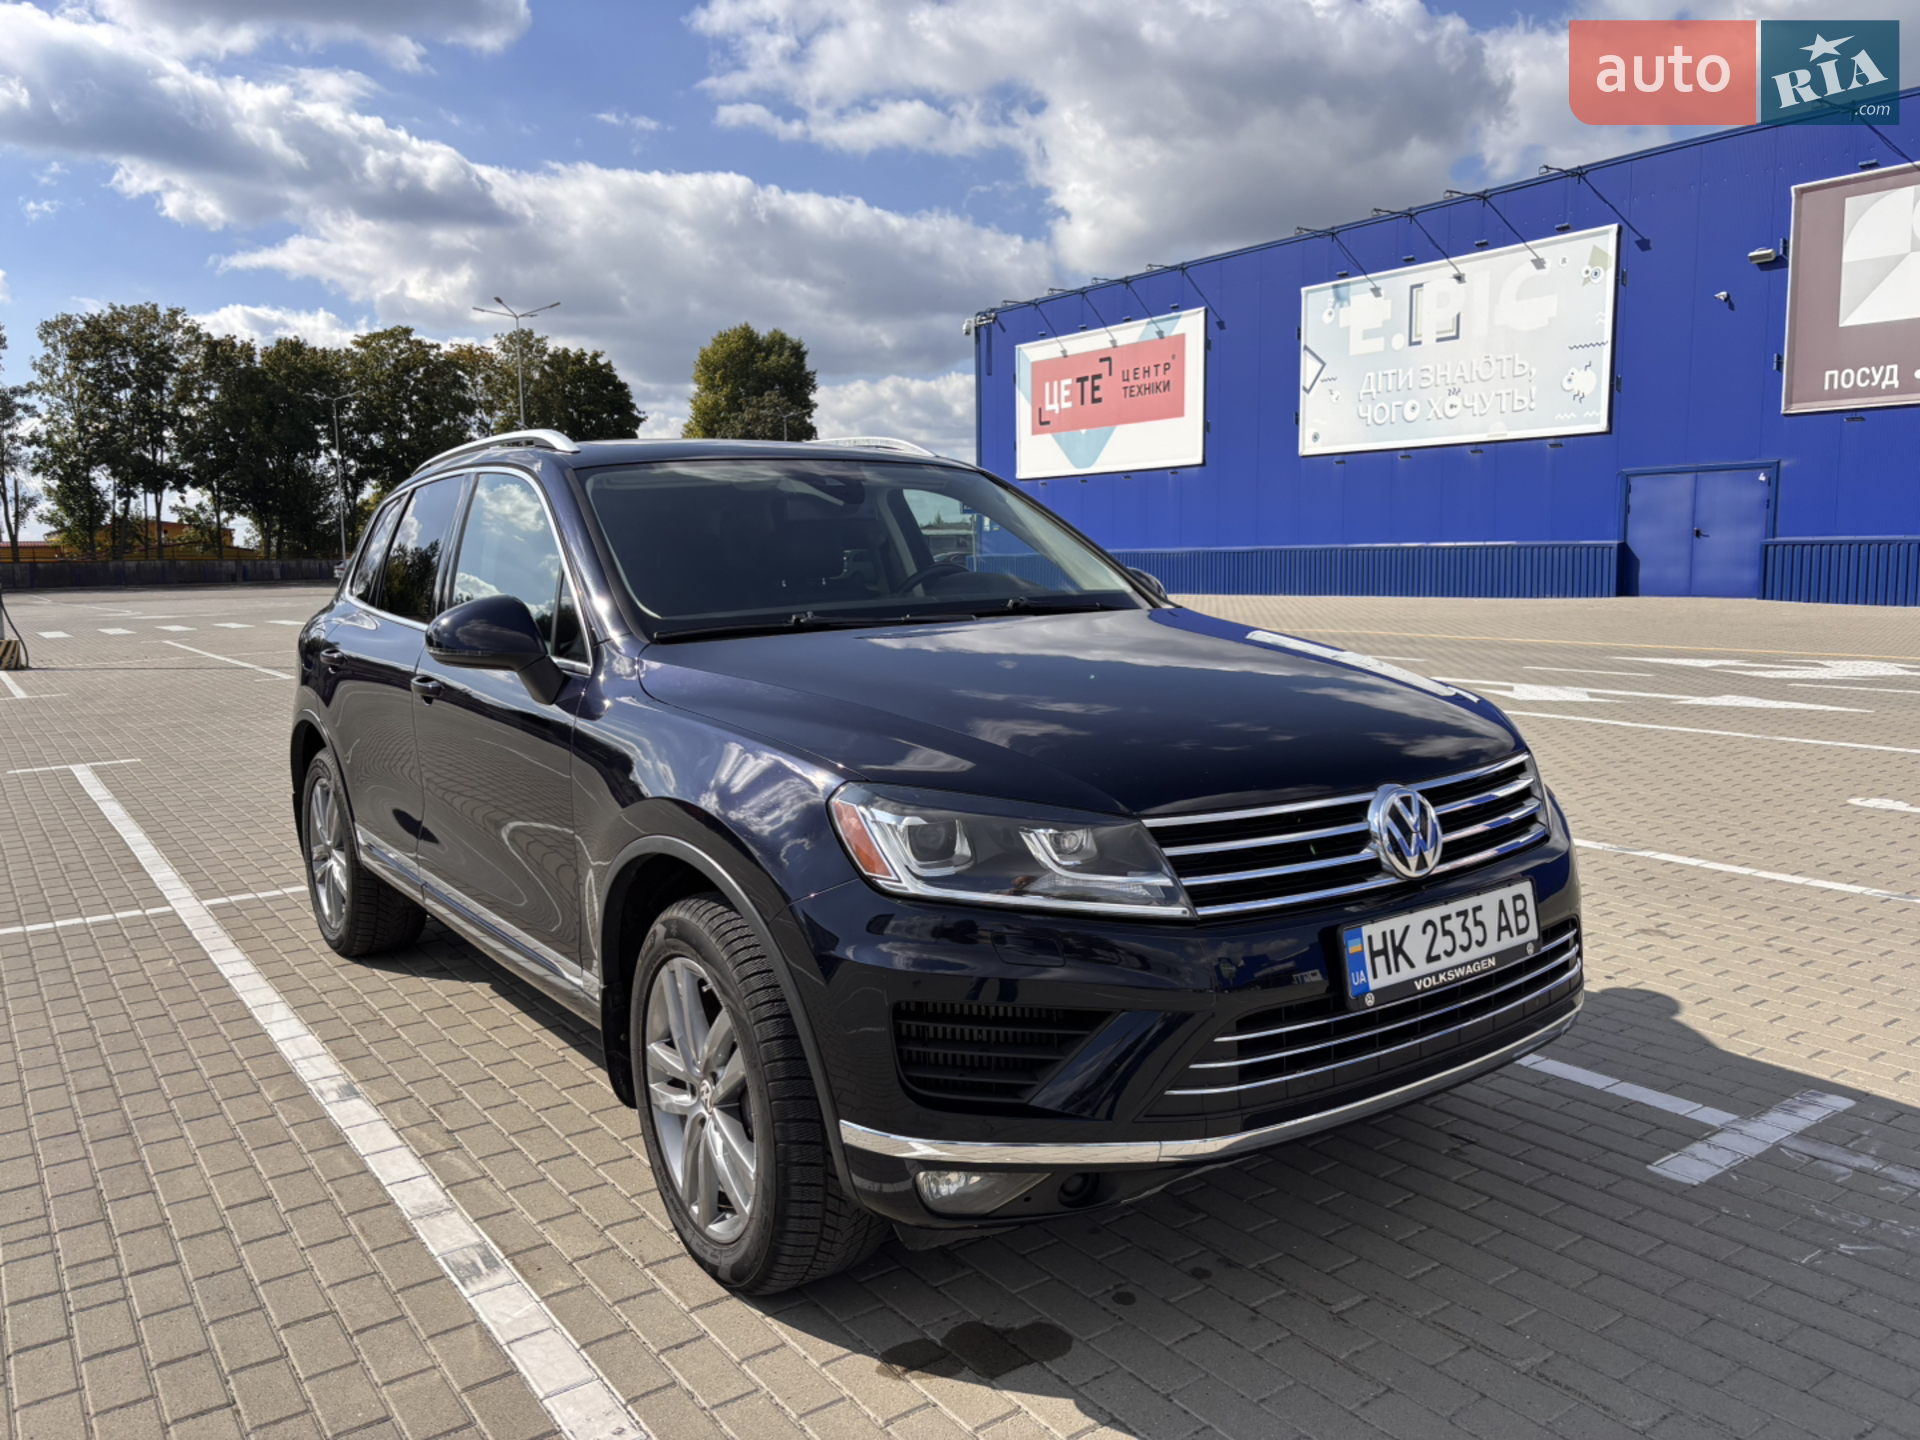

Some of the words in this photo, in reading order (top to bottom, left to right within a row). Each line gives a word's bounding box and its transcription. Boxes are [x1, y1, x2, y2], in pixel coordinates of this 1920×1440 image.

[1122, 362, 1171, 382] ЦЕНТР
[1359, 367, 1413, 401] ДІТИ
[1823, 364, 1899, 391] ПОСУД
[1122, 380, 1171, 399] ТЕХНІКИ
[1358, 400, 1421, 426] ЧОГО
[1427, 386, 1537, 420] ХОЧУТЬ!
[1367, 924, 1416, 980] HK
[1421, 904, 1488, 965] 2535
[1496, 893, 1531, 943] AB
[1351, 969, 1367, 987] UA
[1414, 956, 1496, 991] VOLKSWAGEN
